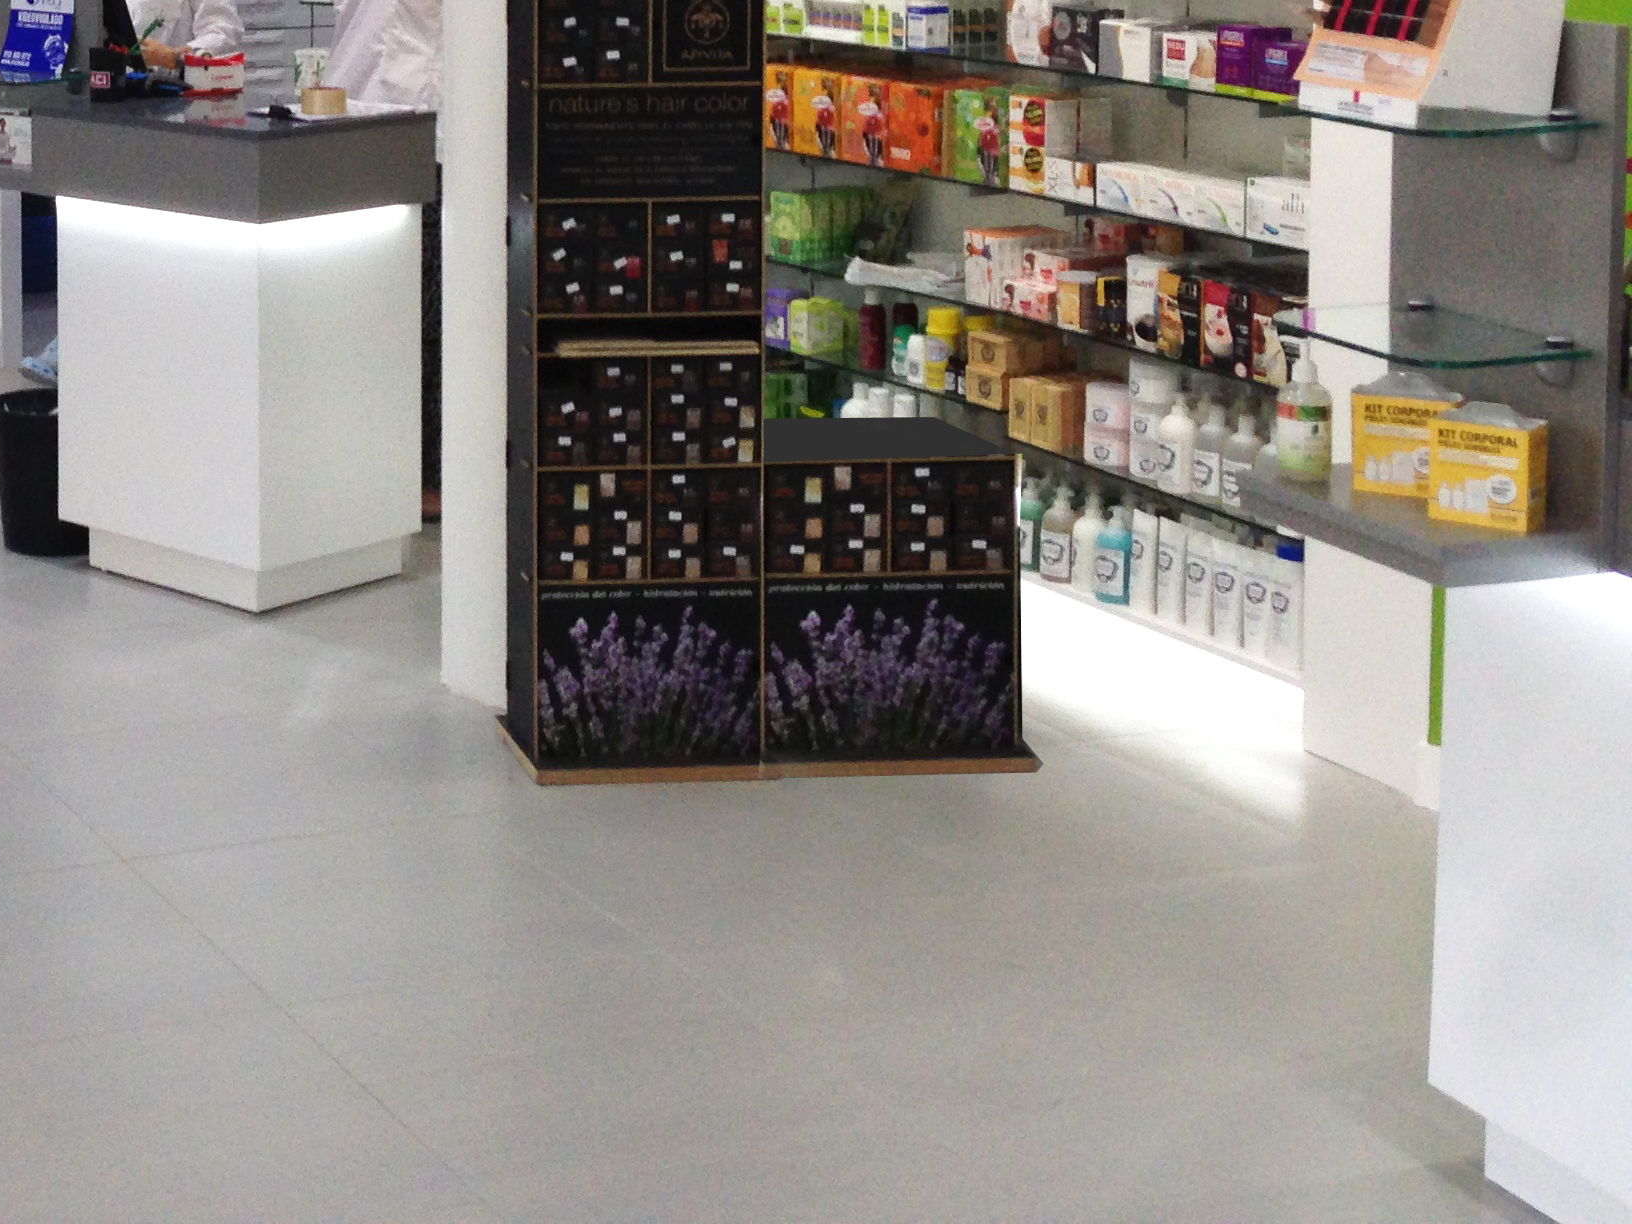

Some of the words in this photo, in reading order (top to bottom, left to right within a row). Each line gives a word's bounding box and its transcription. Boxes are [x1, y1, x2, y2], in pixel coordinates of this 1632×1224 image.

[549, 93, 639, 113] nature's
[647, 93, 687, 113] hair
[694, 93, 748, 113] color
[1364, 403, 1383, 414] KIT
[1386, 405, 1438, 419] CORPORA
[1438, 428, 1457, 440] KIT
[1459, 430, 1518, 448] CORPORAL
